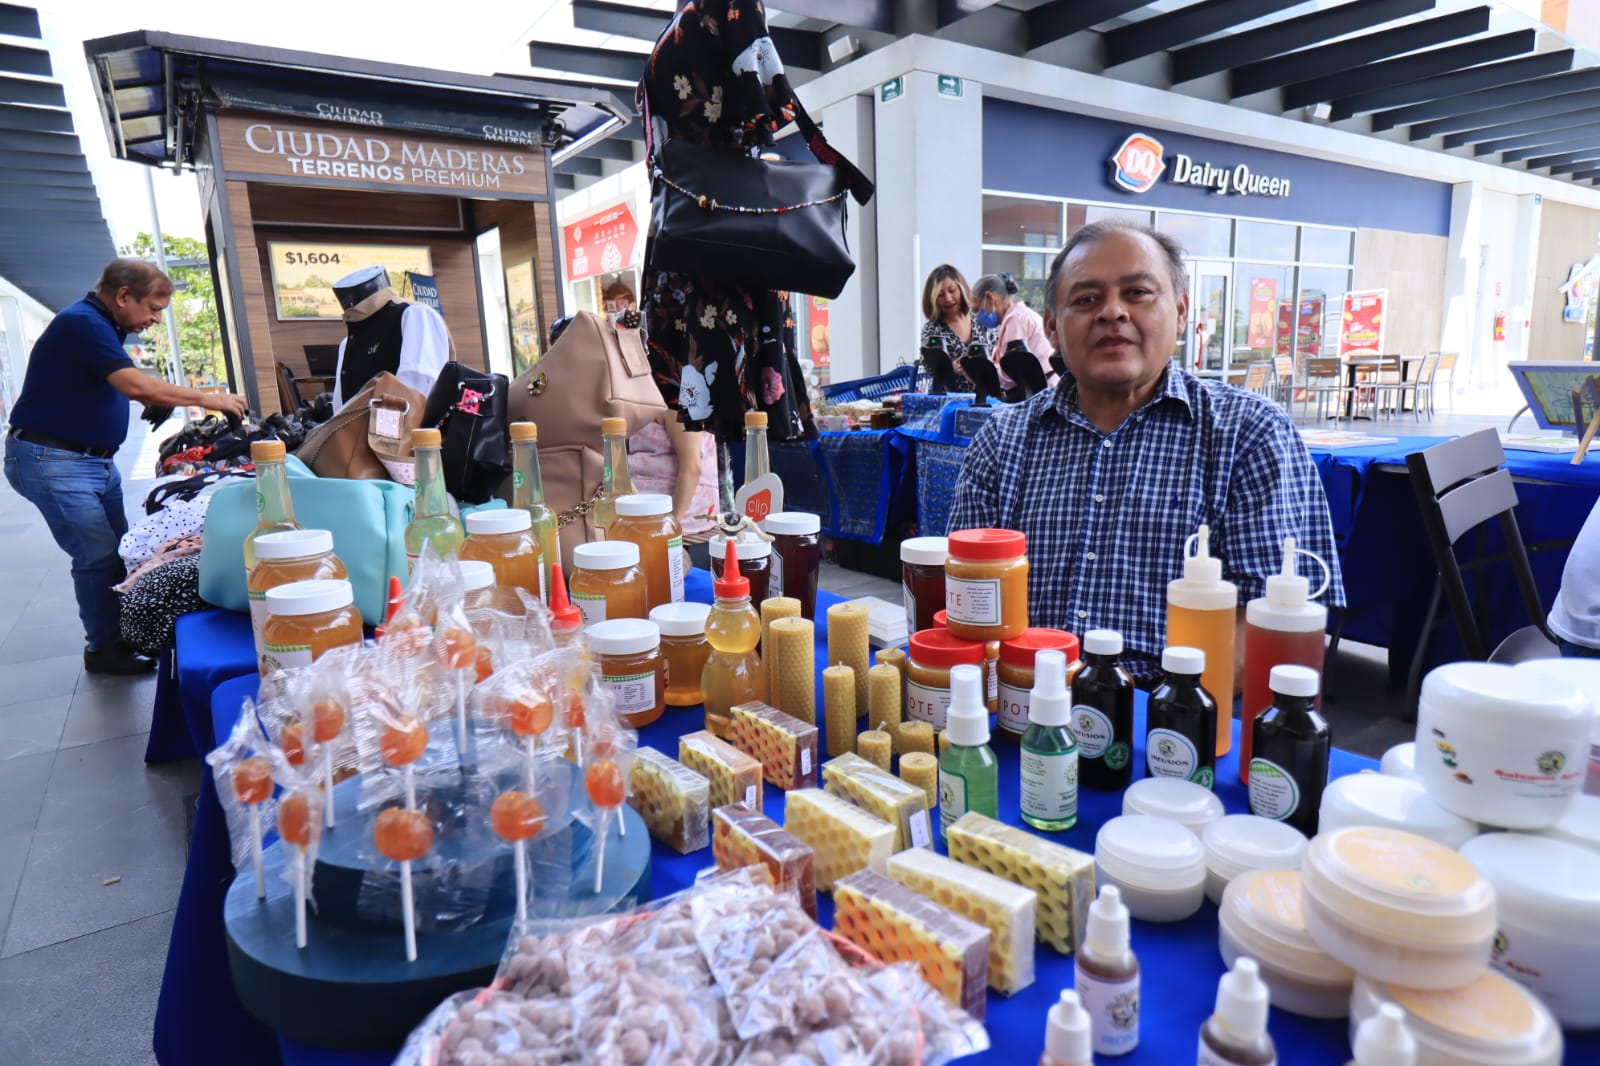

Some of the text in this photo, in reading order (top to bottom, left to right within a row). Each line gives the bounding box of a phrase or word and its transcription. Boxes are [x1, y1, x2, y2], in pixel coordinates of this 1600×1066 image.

[316, 103, 382, 119] CIUDAD
[245, 123, 525, 175] CIUDAD MADERAS
[1125, 147, 1157, 179] DQ
[287, 157, 500, 189] TERRENOS PREMIUM
[1173, 153, 1291, 197] Dairy Queen
[285, 251, 341, 267] $1,604
[748, 498, 769, 517] clip
